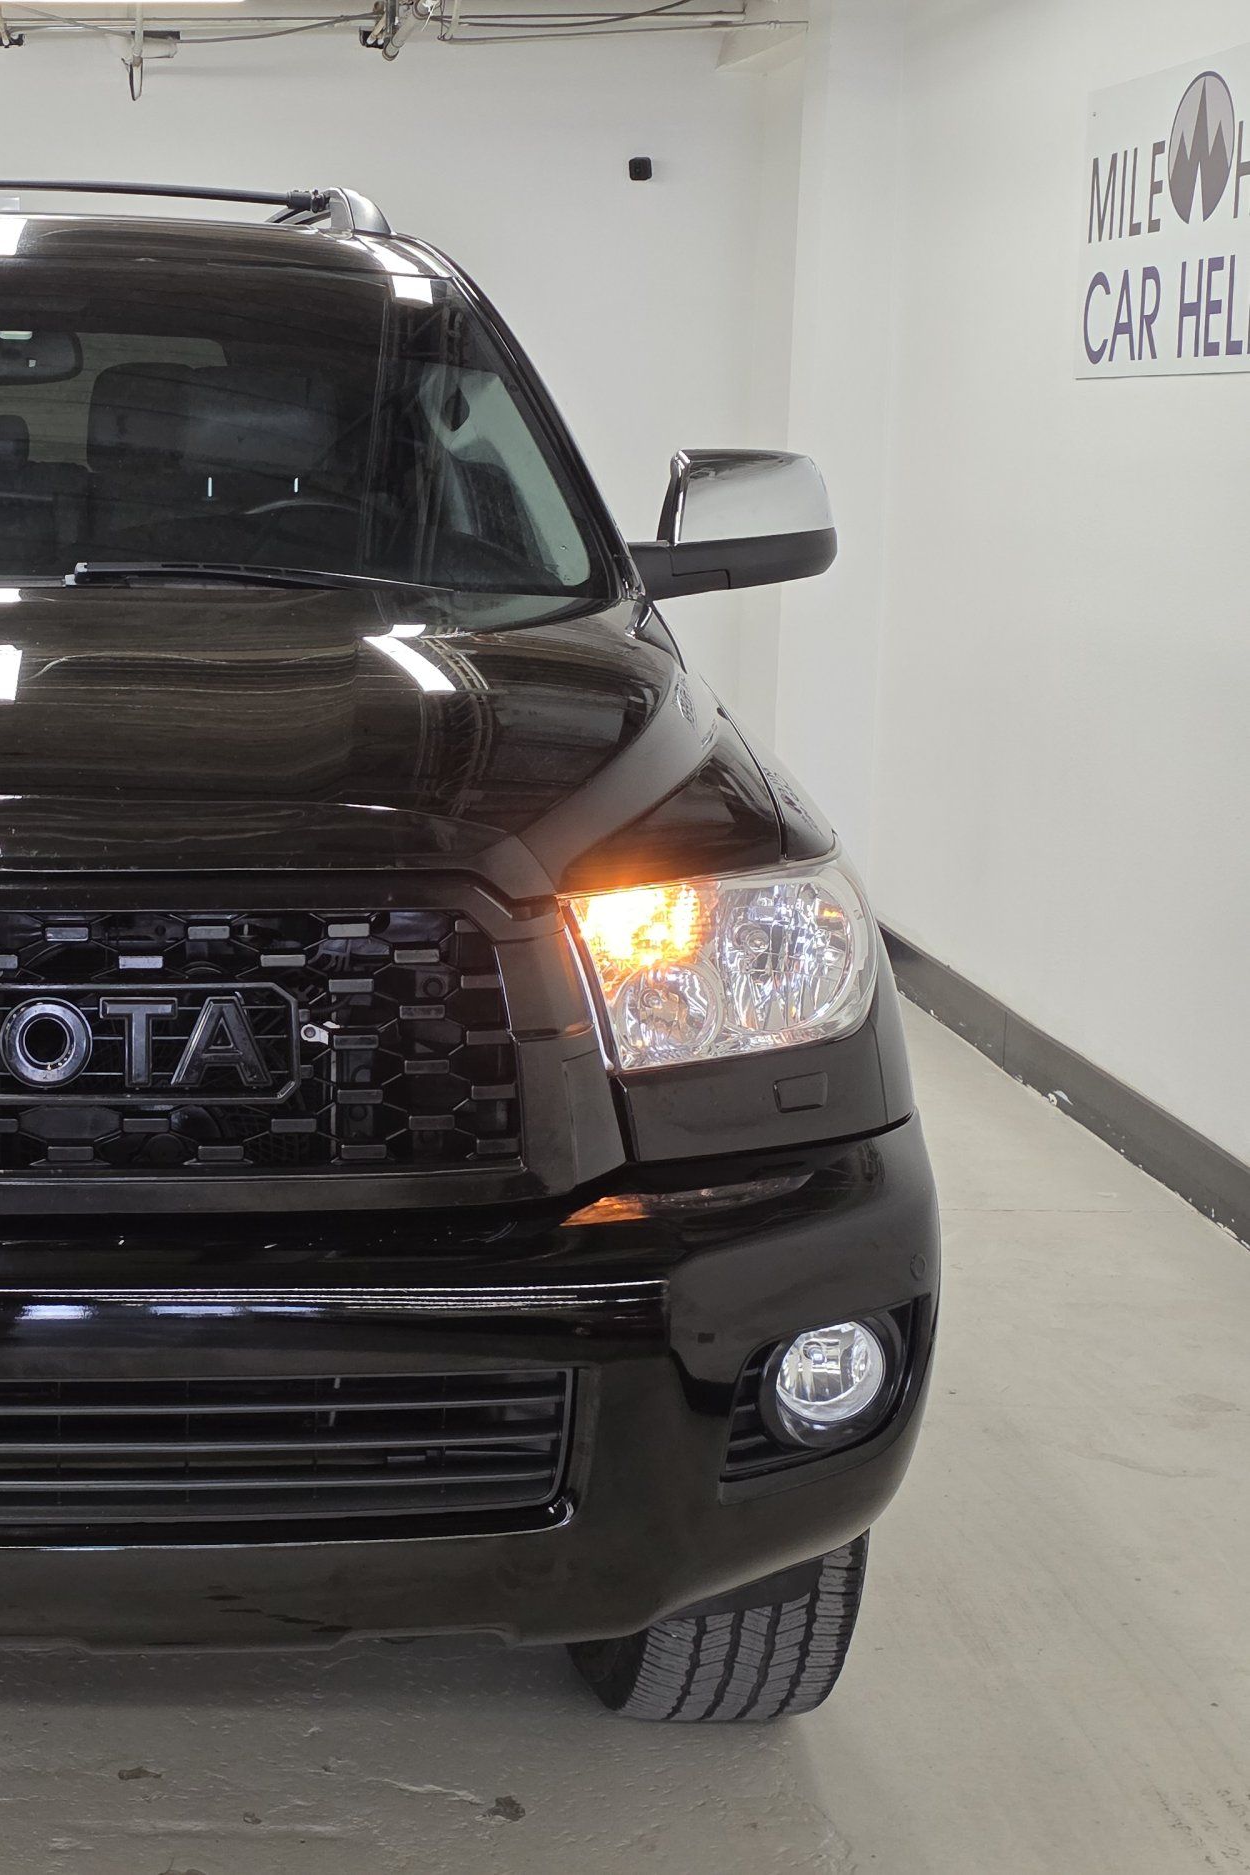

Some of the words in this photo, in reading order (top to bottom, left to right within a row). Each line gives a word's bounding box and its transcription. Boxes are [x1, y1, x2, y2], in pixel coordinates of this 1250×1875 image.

[1087, 139, 1166, 244] MILE
[1083, 265, 1162, 365] CAR
[1176, 254, 1250, 359] HEL
